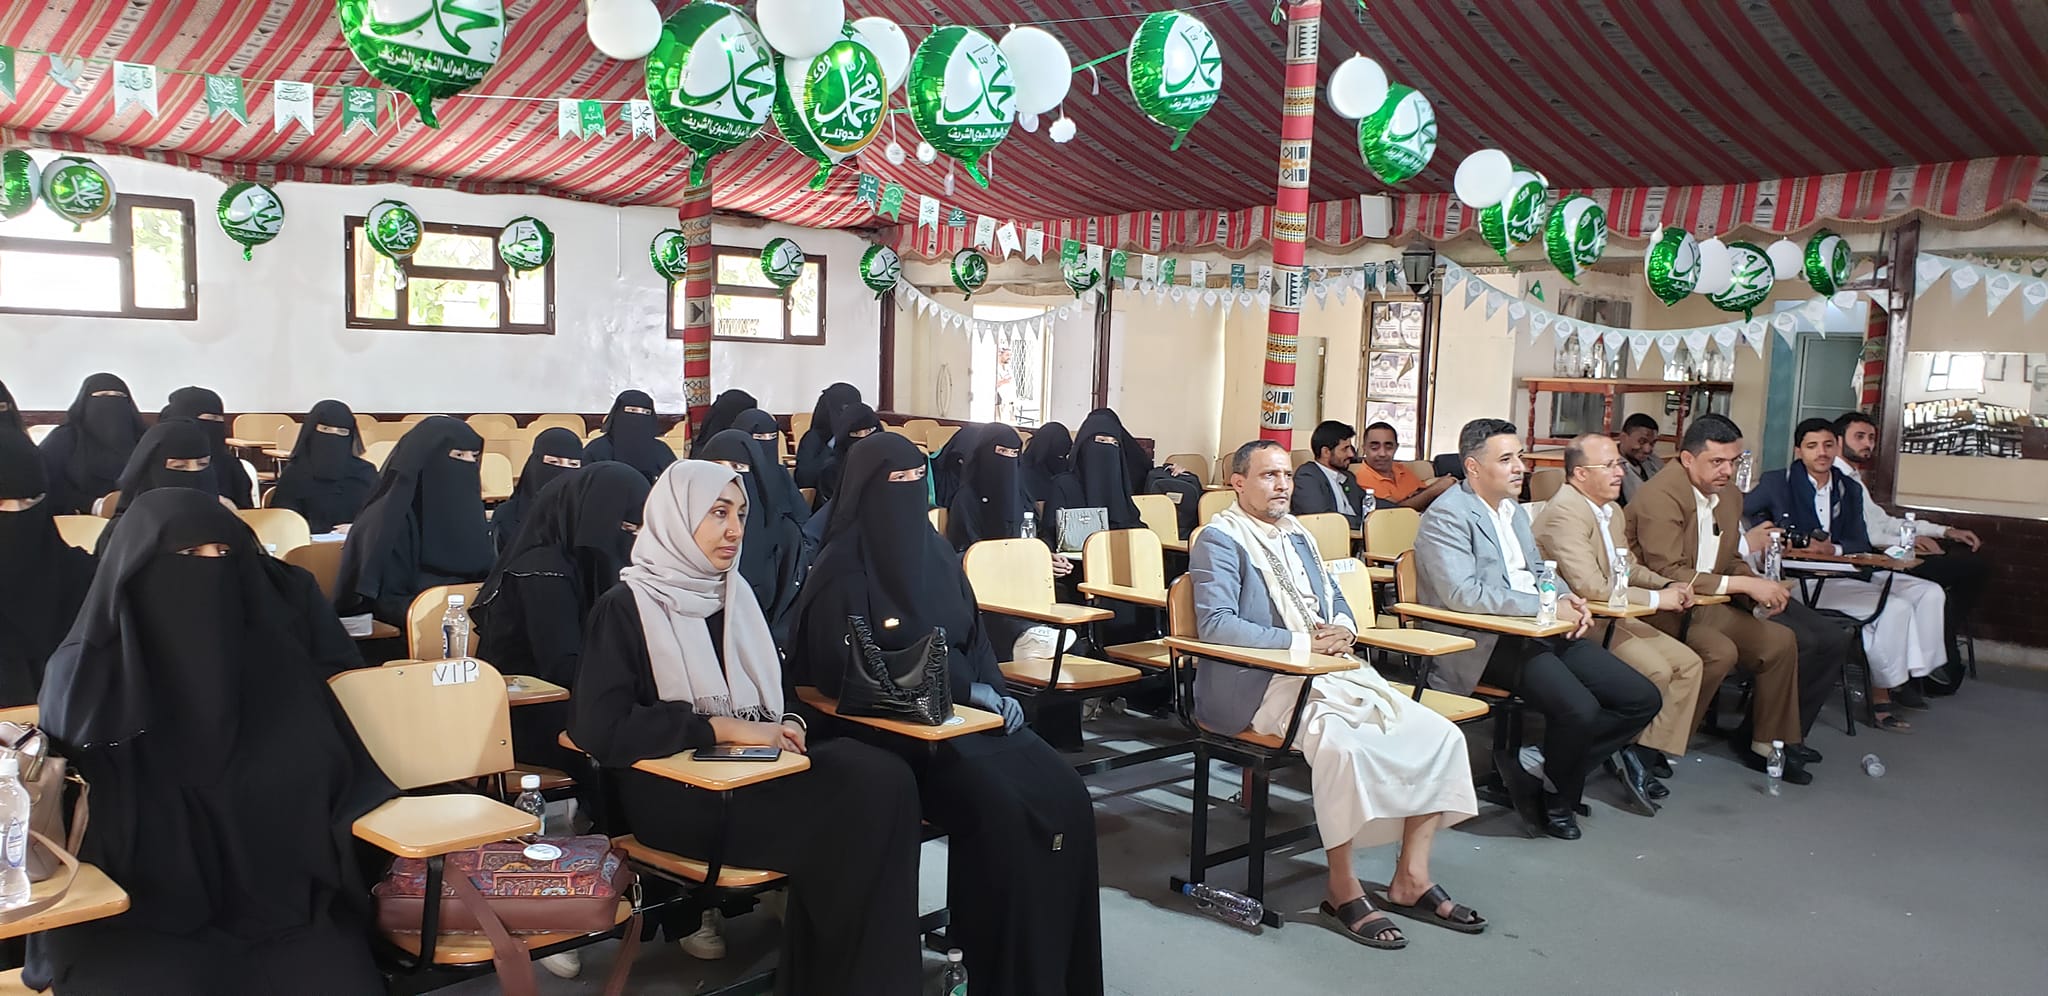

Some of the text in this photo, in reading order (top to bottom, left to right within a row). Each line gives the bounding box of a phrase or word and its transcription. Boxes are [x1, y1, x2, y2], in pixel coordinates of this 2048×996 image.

[378, 44, 415, 67] الشريف
[678, 32, 776, 120] محمد
[1164, 31, 1222, 94] محمد
[814, 58, 882, 128] محمد
[942, 51, 1016, 122] محمد
[681, 112, 712, 131] الشريف
[820, 127, 865, 142] قدوتنا
[433, 660, 478, 683] VIP
